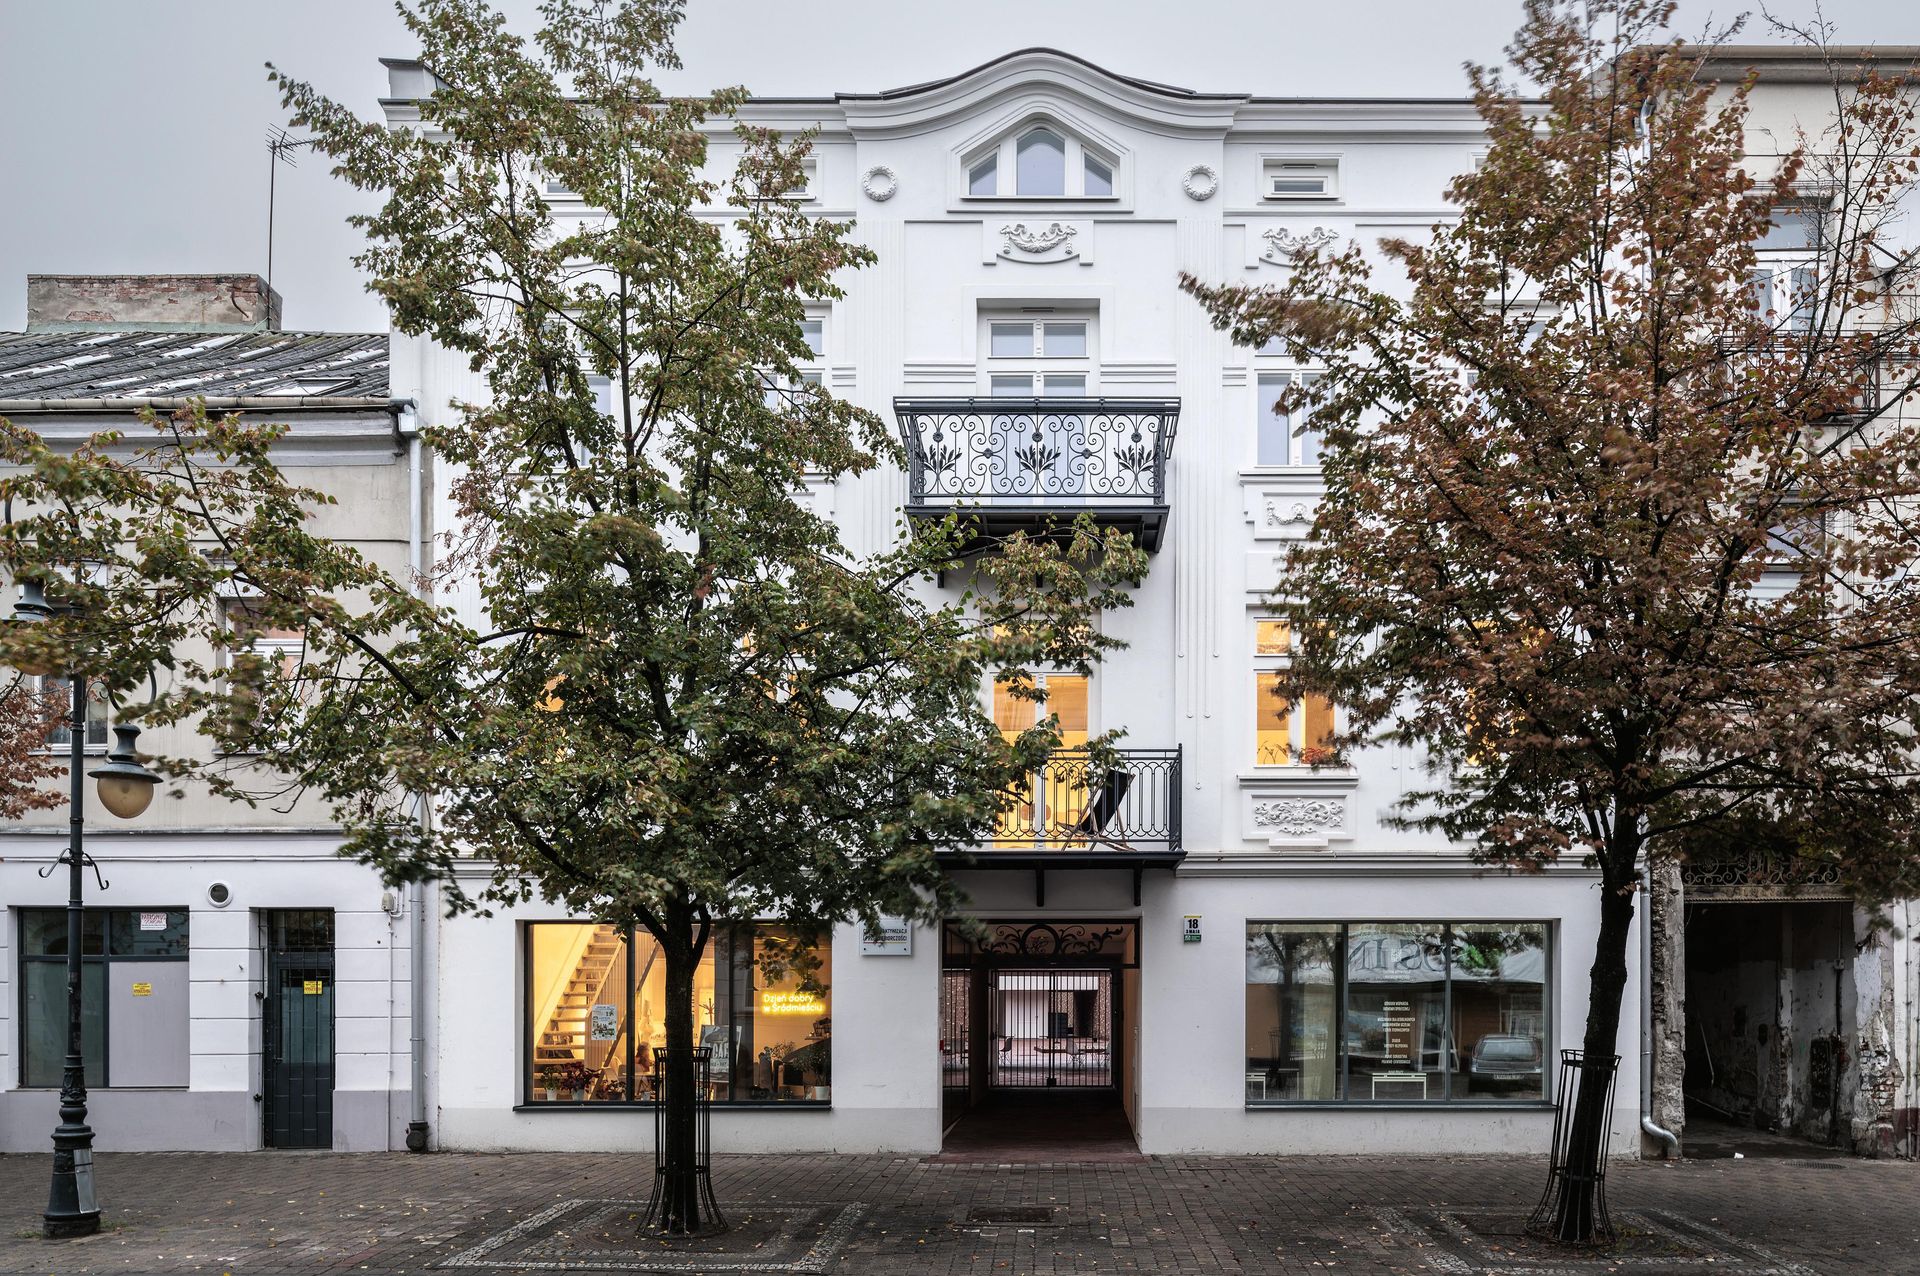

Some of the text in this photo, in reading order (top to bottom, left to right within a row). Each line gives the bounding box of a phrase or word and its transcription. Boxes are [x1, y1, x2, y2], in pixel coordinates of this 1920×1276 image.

[1188, 919, 1198, 928] 18
[763, 993, 814, 1003] Dzień dobry
[772, 1002, 823, 1012] Śródmieściu
[712, 1043, 729, 1058] CAF
